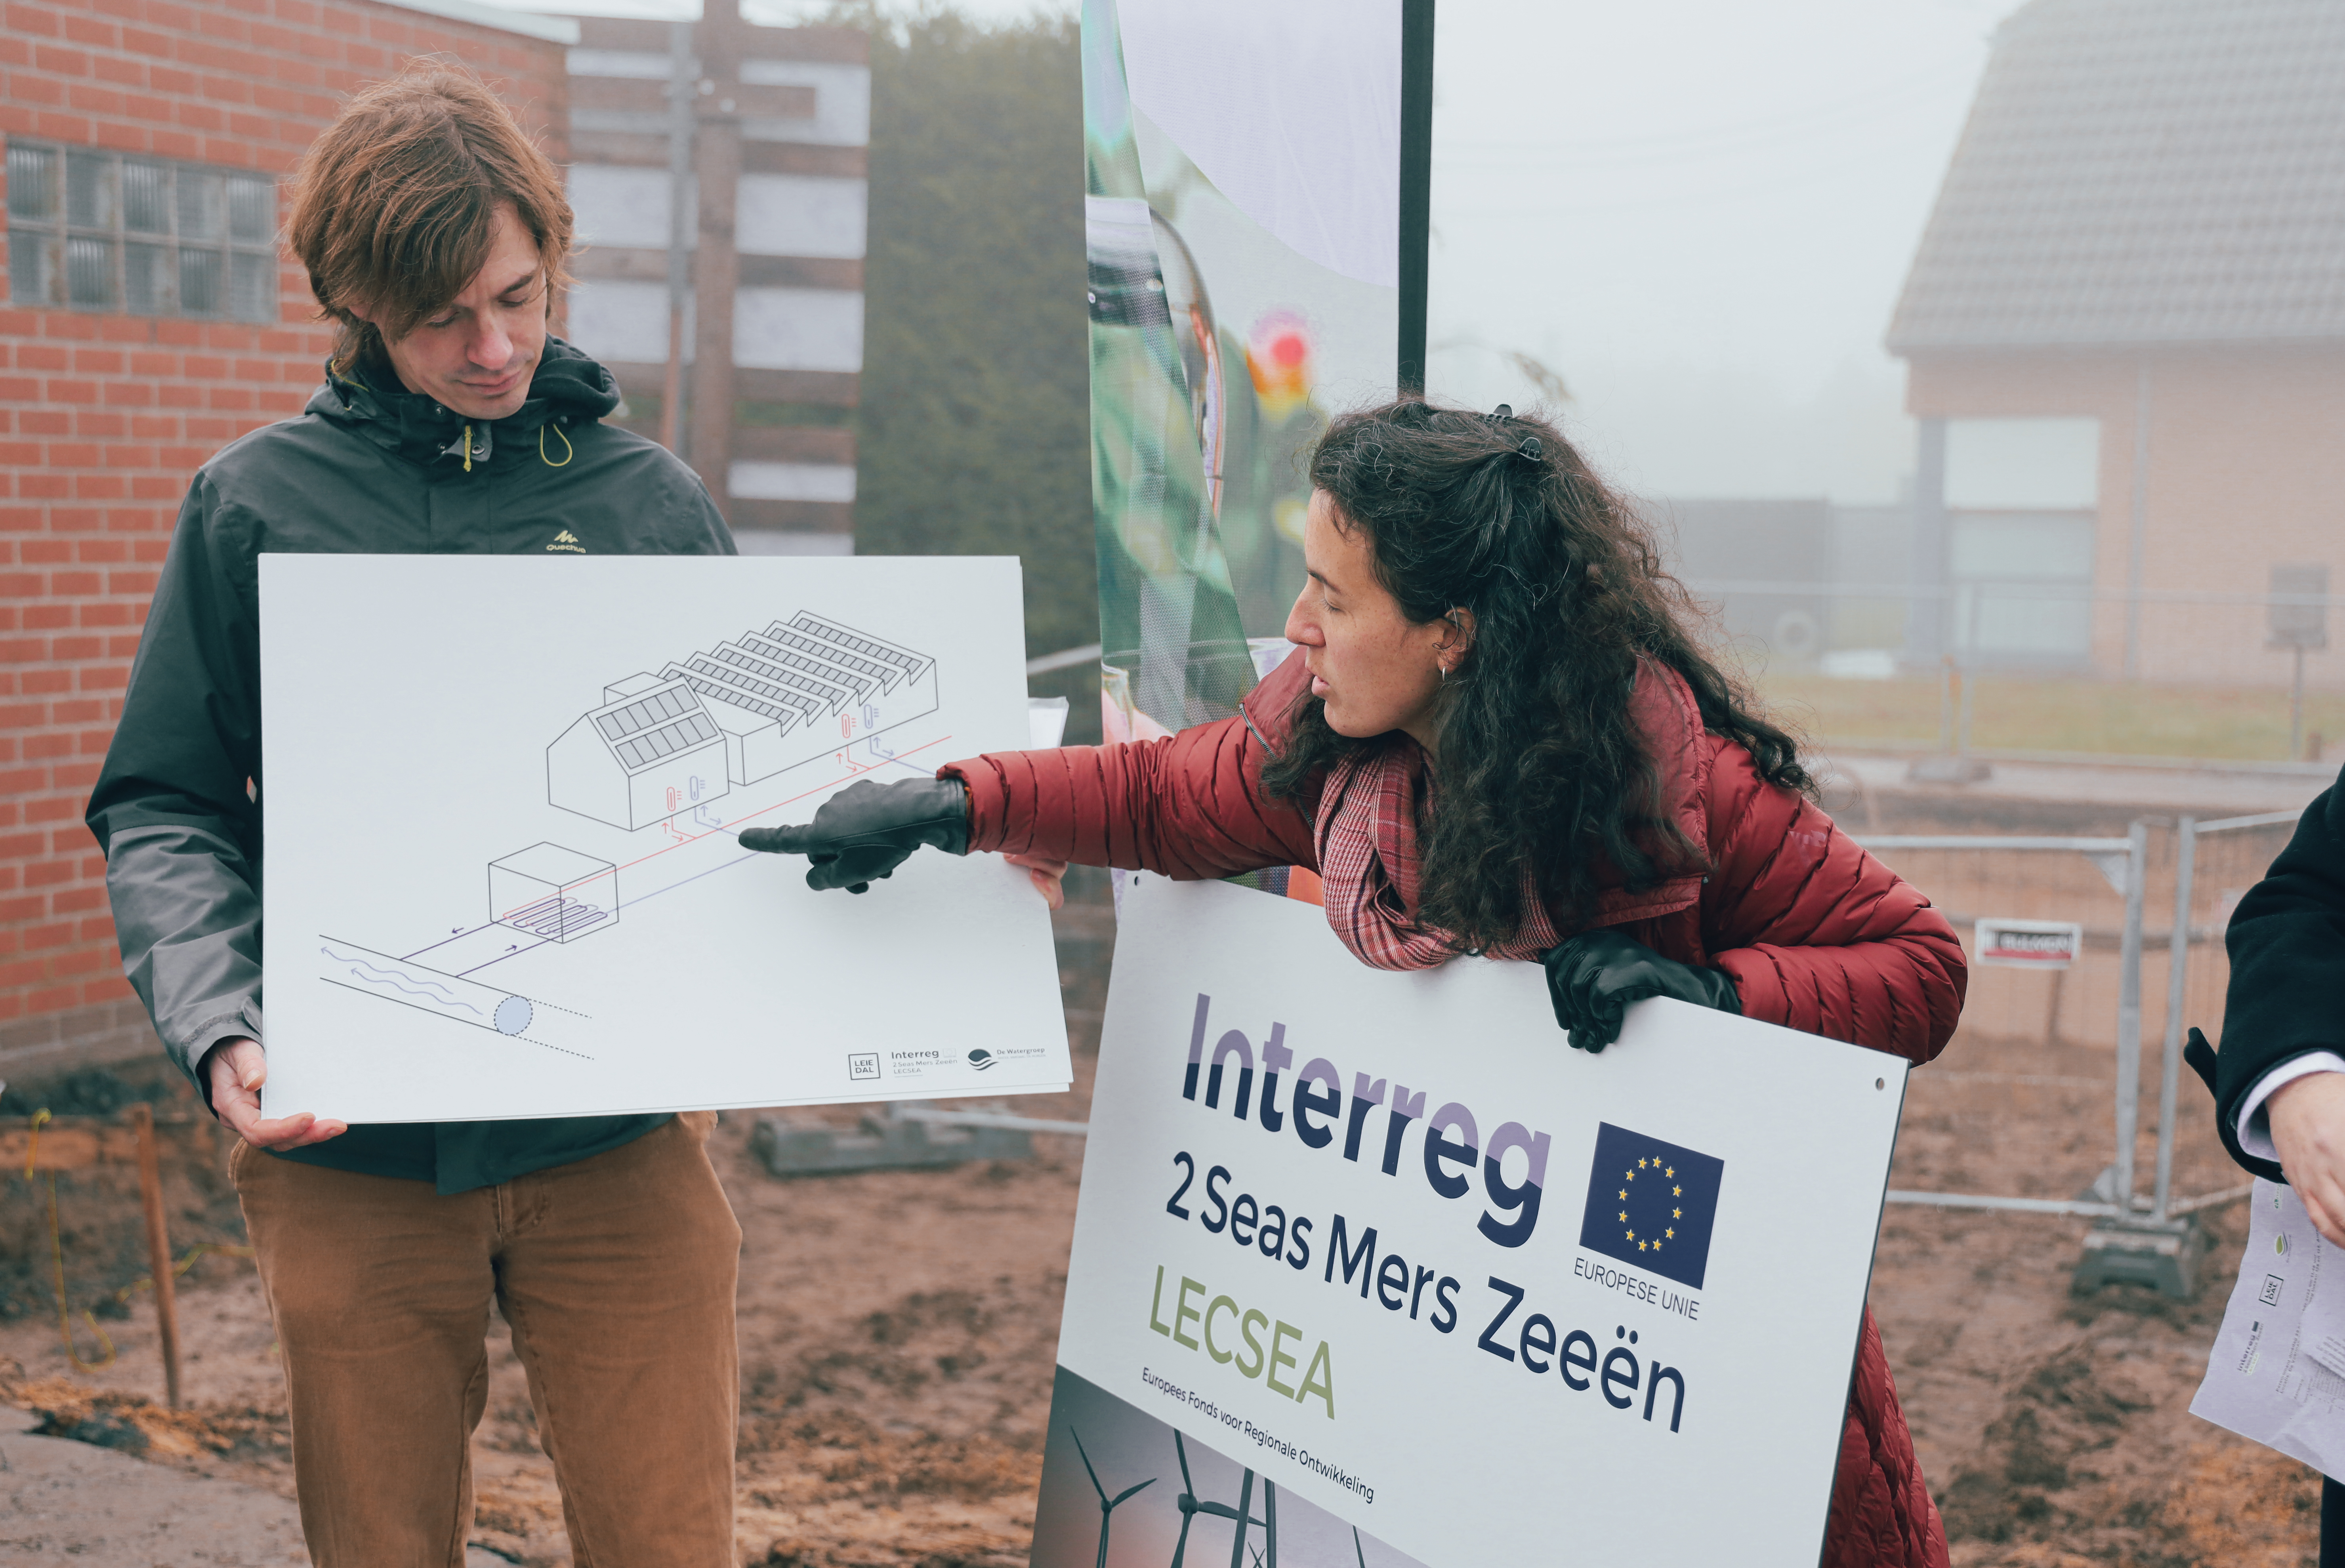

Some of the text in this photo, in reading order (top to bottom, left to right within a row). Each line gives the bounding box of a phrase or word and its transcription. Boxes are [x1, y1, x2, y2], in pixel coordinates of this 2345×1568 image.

[546, 544, 586, 553] Quechua
[891, 1050, 939, 1059] Interreg
[1183, 993, 1551, 1248] Interreg
[1166, 1151, 1685, 1434] 2 Seas Mers Zeeën
[1574, 1257, 1700, 1321] EUROPESE UNIE
[2264, 1280, 2273, 1298] LEIE
[2269, 1282, 2277, 1299] DAL
[1150, 1265, 1335, 1420] LECSEA
[2236, 1334, 2256, 1371] Interreg
[1142, 1367, 1374, 1504] Europees Fonds voor Regionale Ontwikkeling
